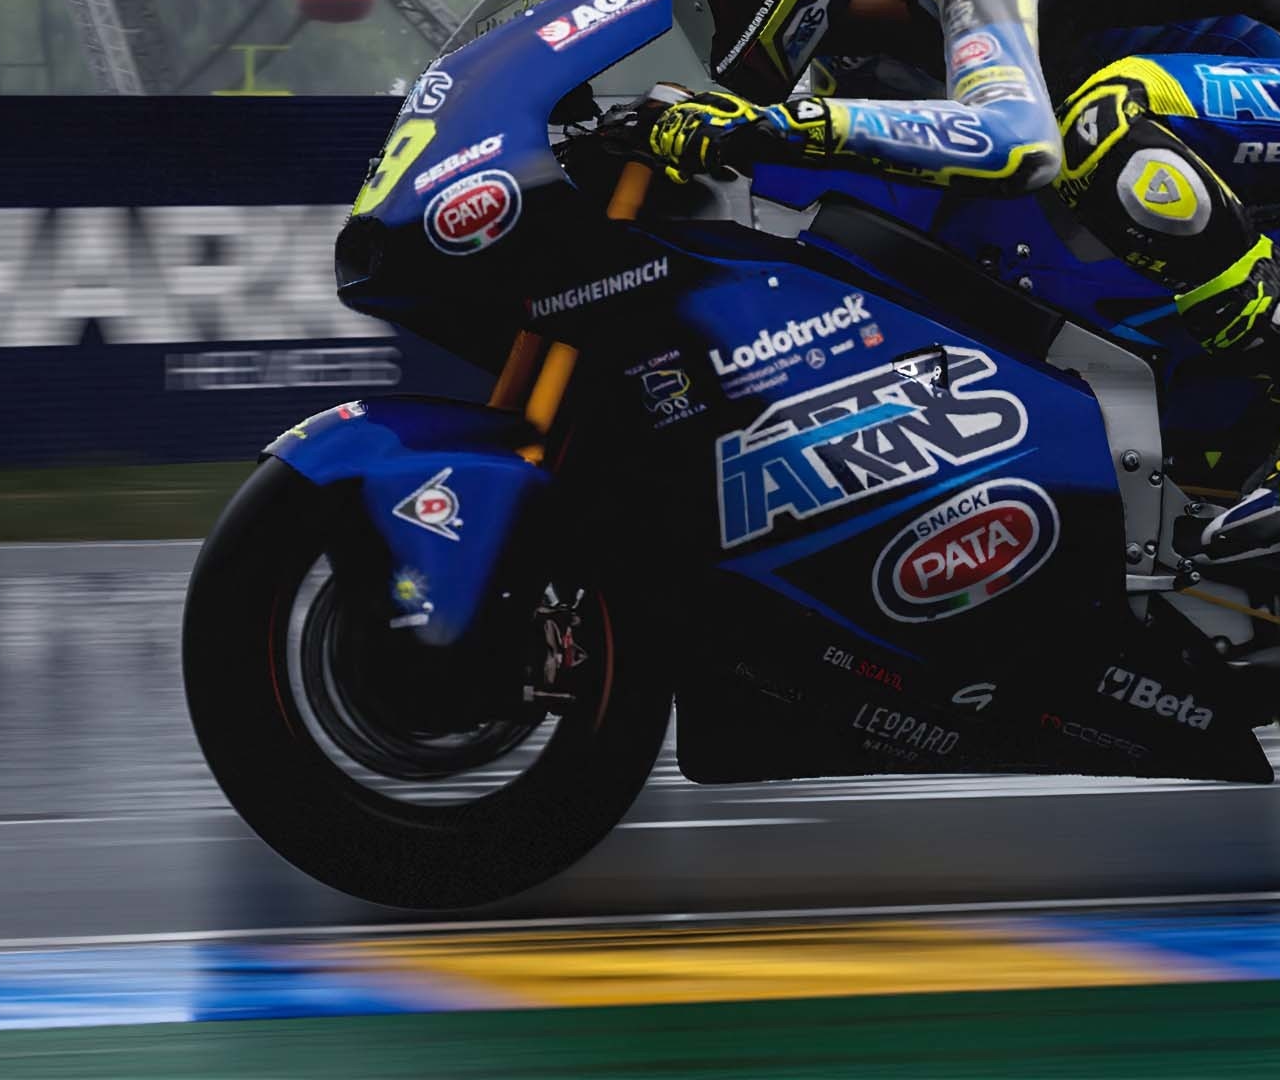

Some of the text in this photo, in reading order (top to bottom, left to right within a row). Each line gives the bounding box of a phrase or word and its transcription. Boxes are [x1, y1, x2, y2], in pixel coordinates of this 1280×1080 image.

[443, 190, 500, 234] PATA
[530, 256, 669, 318] JUNGHEINRICH
[708, 293, 872, 376] Lodotruck
[919, 491, 988, 538] SNACK
[911, 520, 1021, 591] PATA
[852, 702, 961, 756] LEOPARD
[1128, 676, 1214, 731] Beta
